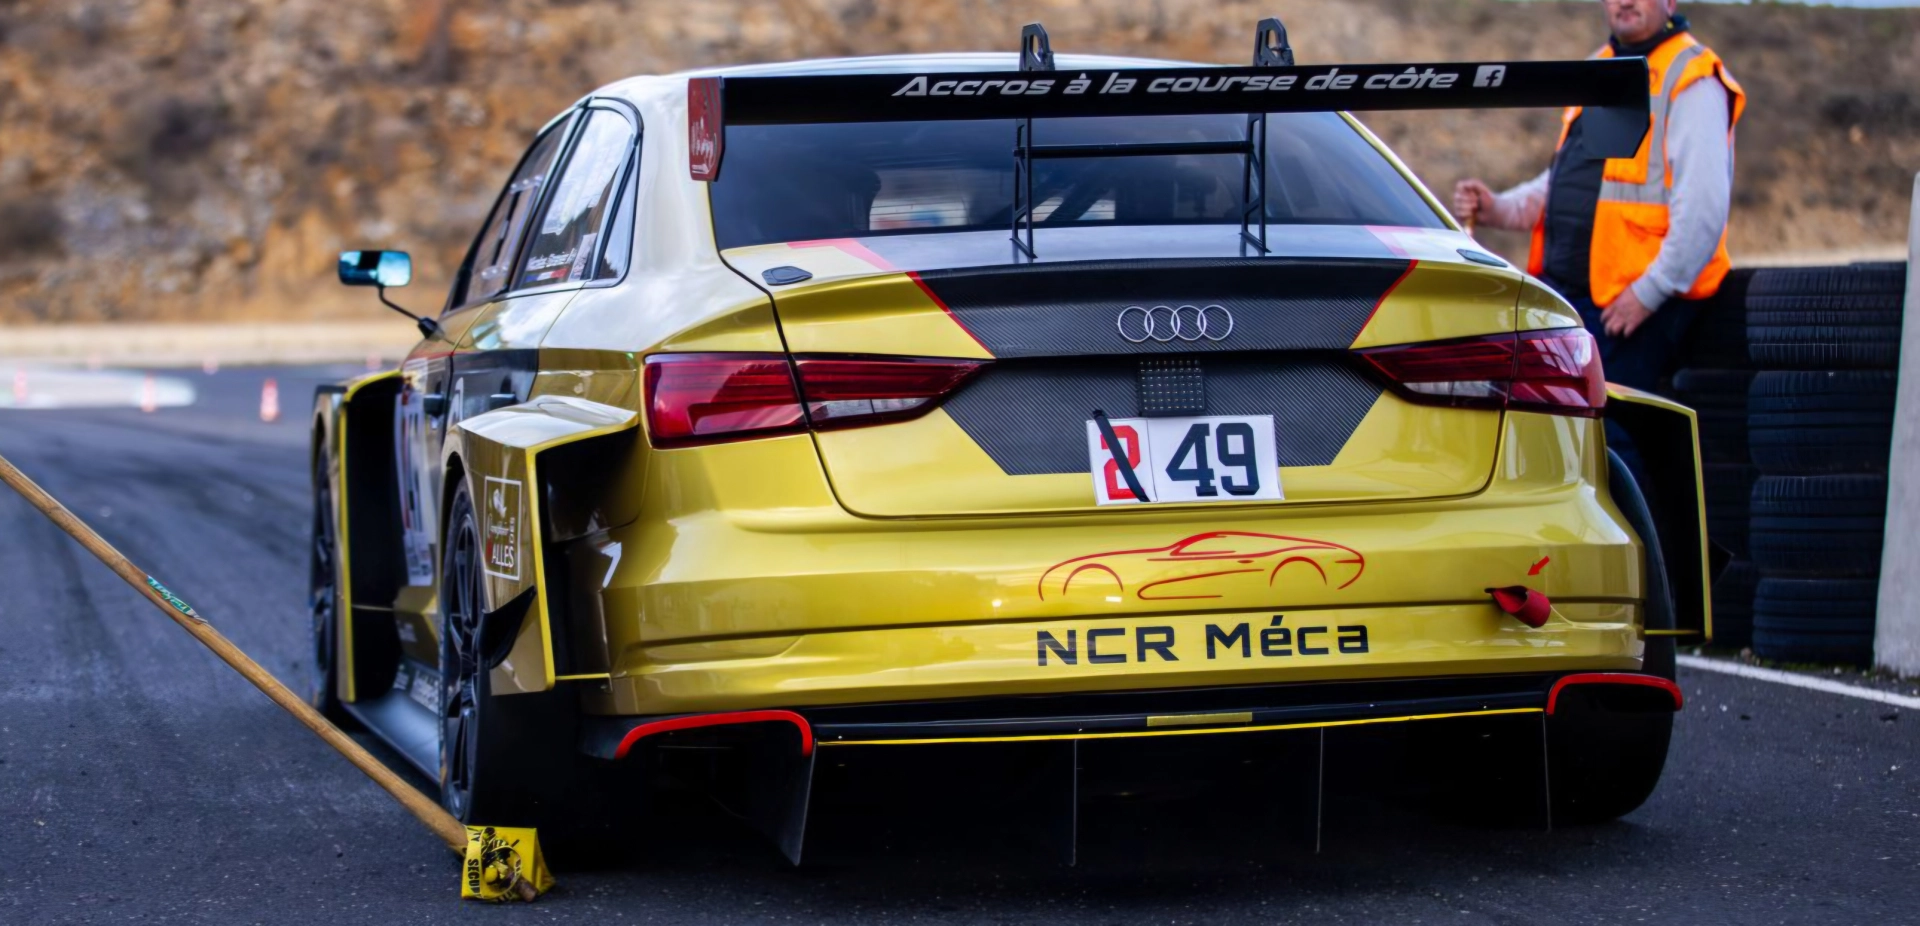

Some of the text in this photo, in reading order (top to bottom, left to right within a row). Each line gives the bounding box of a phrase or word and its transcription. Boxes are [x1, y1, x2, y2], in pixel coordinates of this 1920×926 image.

[891, 75, 1055, 96] Accros
[1063, 73, 1092, 94] à
[1099, 72, 1137, 94] la
[1147, 76, 1297, 94] course
[1304, 68, 1358, 90] de
[1363, 66, 1459, 90] côte
[1100, 422, 1260, 500] 2 49
[1037, 615, 1369, 667] NCR Méca
